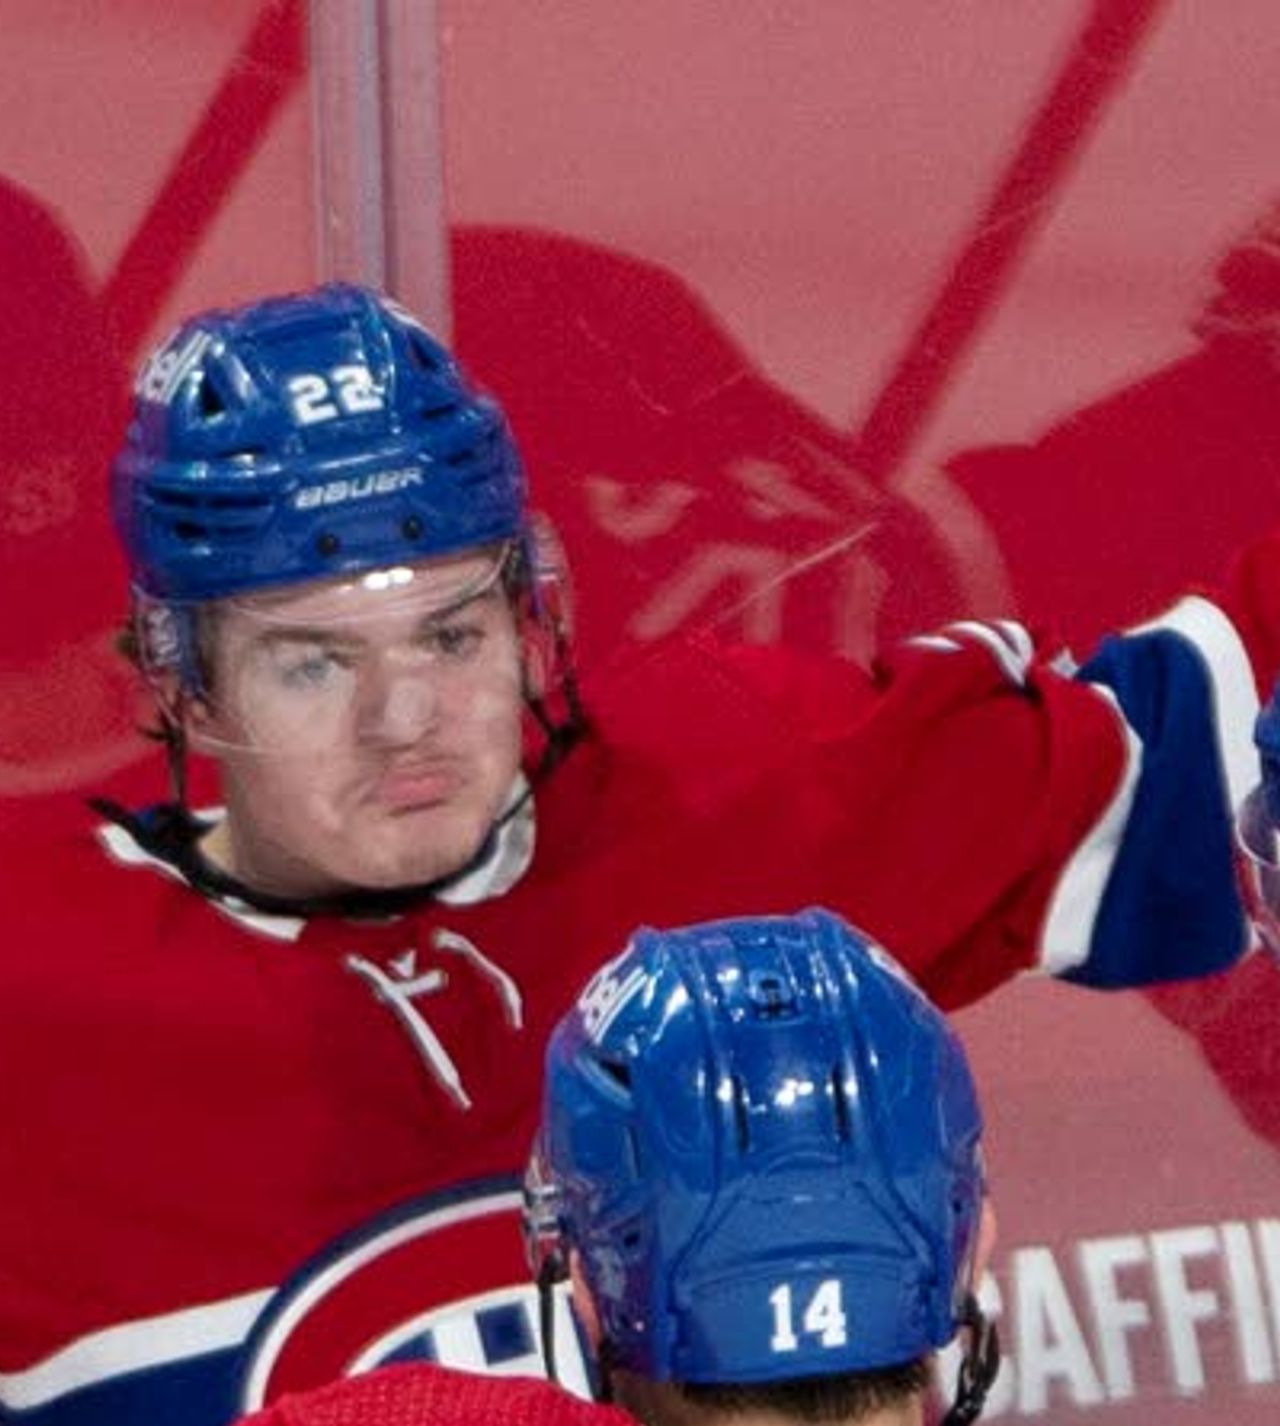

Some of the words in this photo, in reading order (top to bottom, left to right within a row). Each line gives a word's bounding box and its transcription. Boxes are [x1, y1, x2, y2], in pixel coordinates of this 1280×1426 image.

[287, 365, 384, 426] 22
[295, 465, 424, 510] BAUER
[767, 1279, 847, 1353] 14
